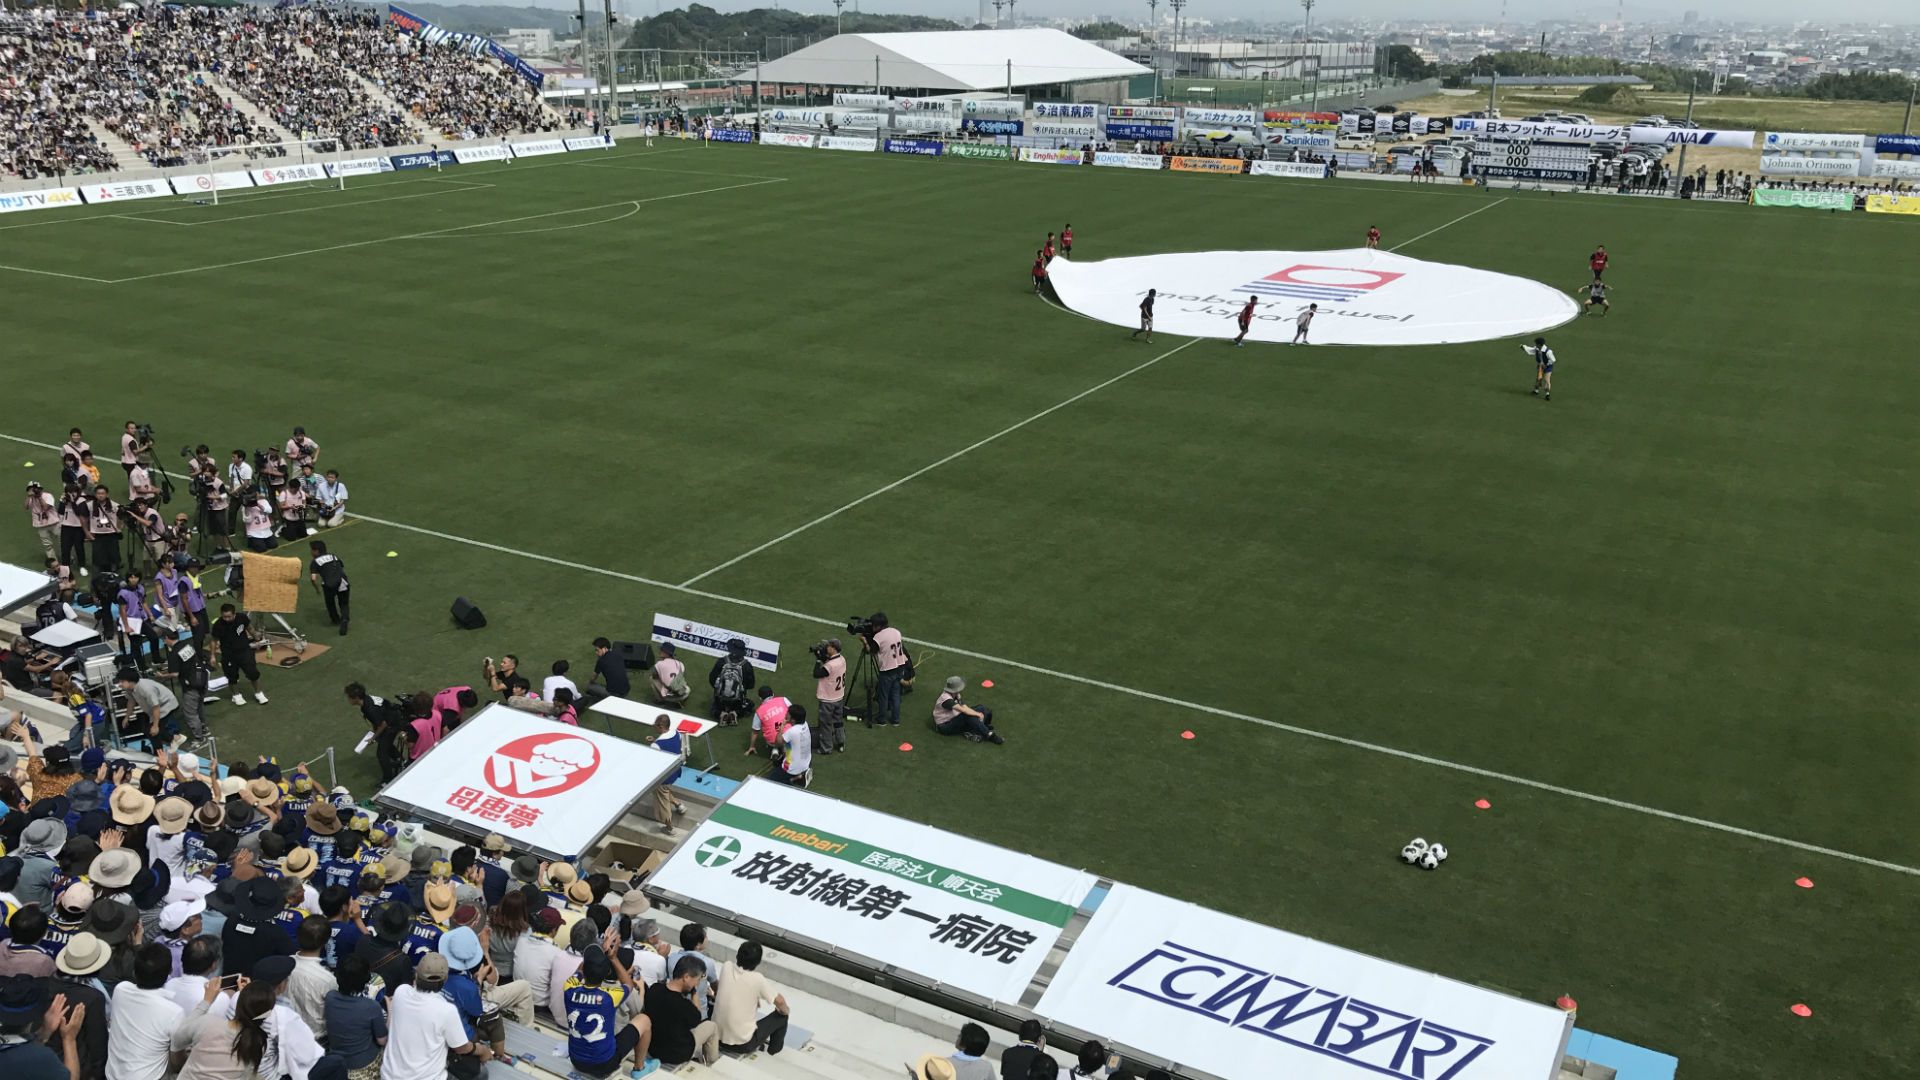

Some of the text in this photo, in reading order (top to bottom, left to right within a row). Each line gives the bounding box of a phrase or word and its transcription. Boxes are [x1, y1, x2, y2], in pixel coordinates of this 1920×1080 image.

[1037, 104, 1094, 118] 今治南病院
[1212, 112, 1252, 123] カナックス
[1455, 121, 1478, 131] JFL
[1486, 122, 1619, 140] 日本フットボールリーグ
[1284, 135, 1330, 146] Sanikleen
[1664, 132, 1699, 144] ANA
[951, 146, 1008, 158] 今治プラザホテル
[1767, 159, 1852, 169] Johnan Orimono
[113, 184, 157, 197] 三菱商事
[1791, 193, 1845, 206] 白石病院
[677, 632, 701, 645] FC今治
[702, 639, 713, 647] VS
[714, 641, 753, 658] ヴェル分
[764, 705, 785, 722] STAFF
[769, 824, 1004, 904] Imabari 医療法人 順天会
[731, 850, 1039, 966] 放射線第一病院
[571, 991, 597, 1005] LDH
[567, 1008, 608, 1043] 12
